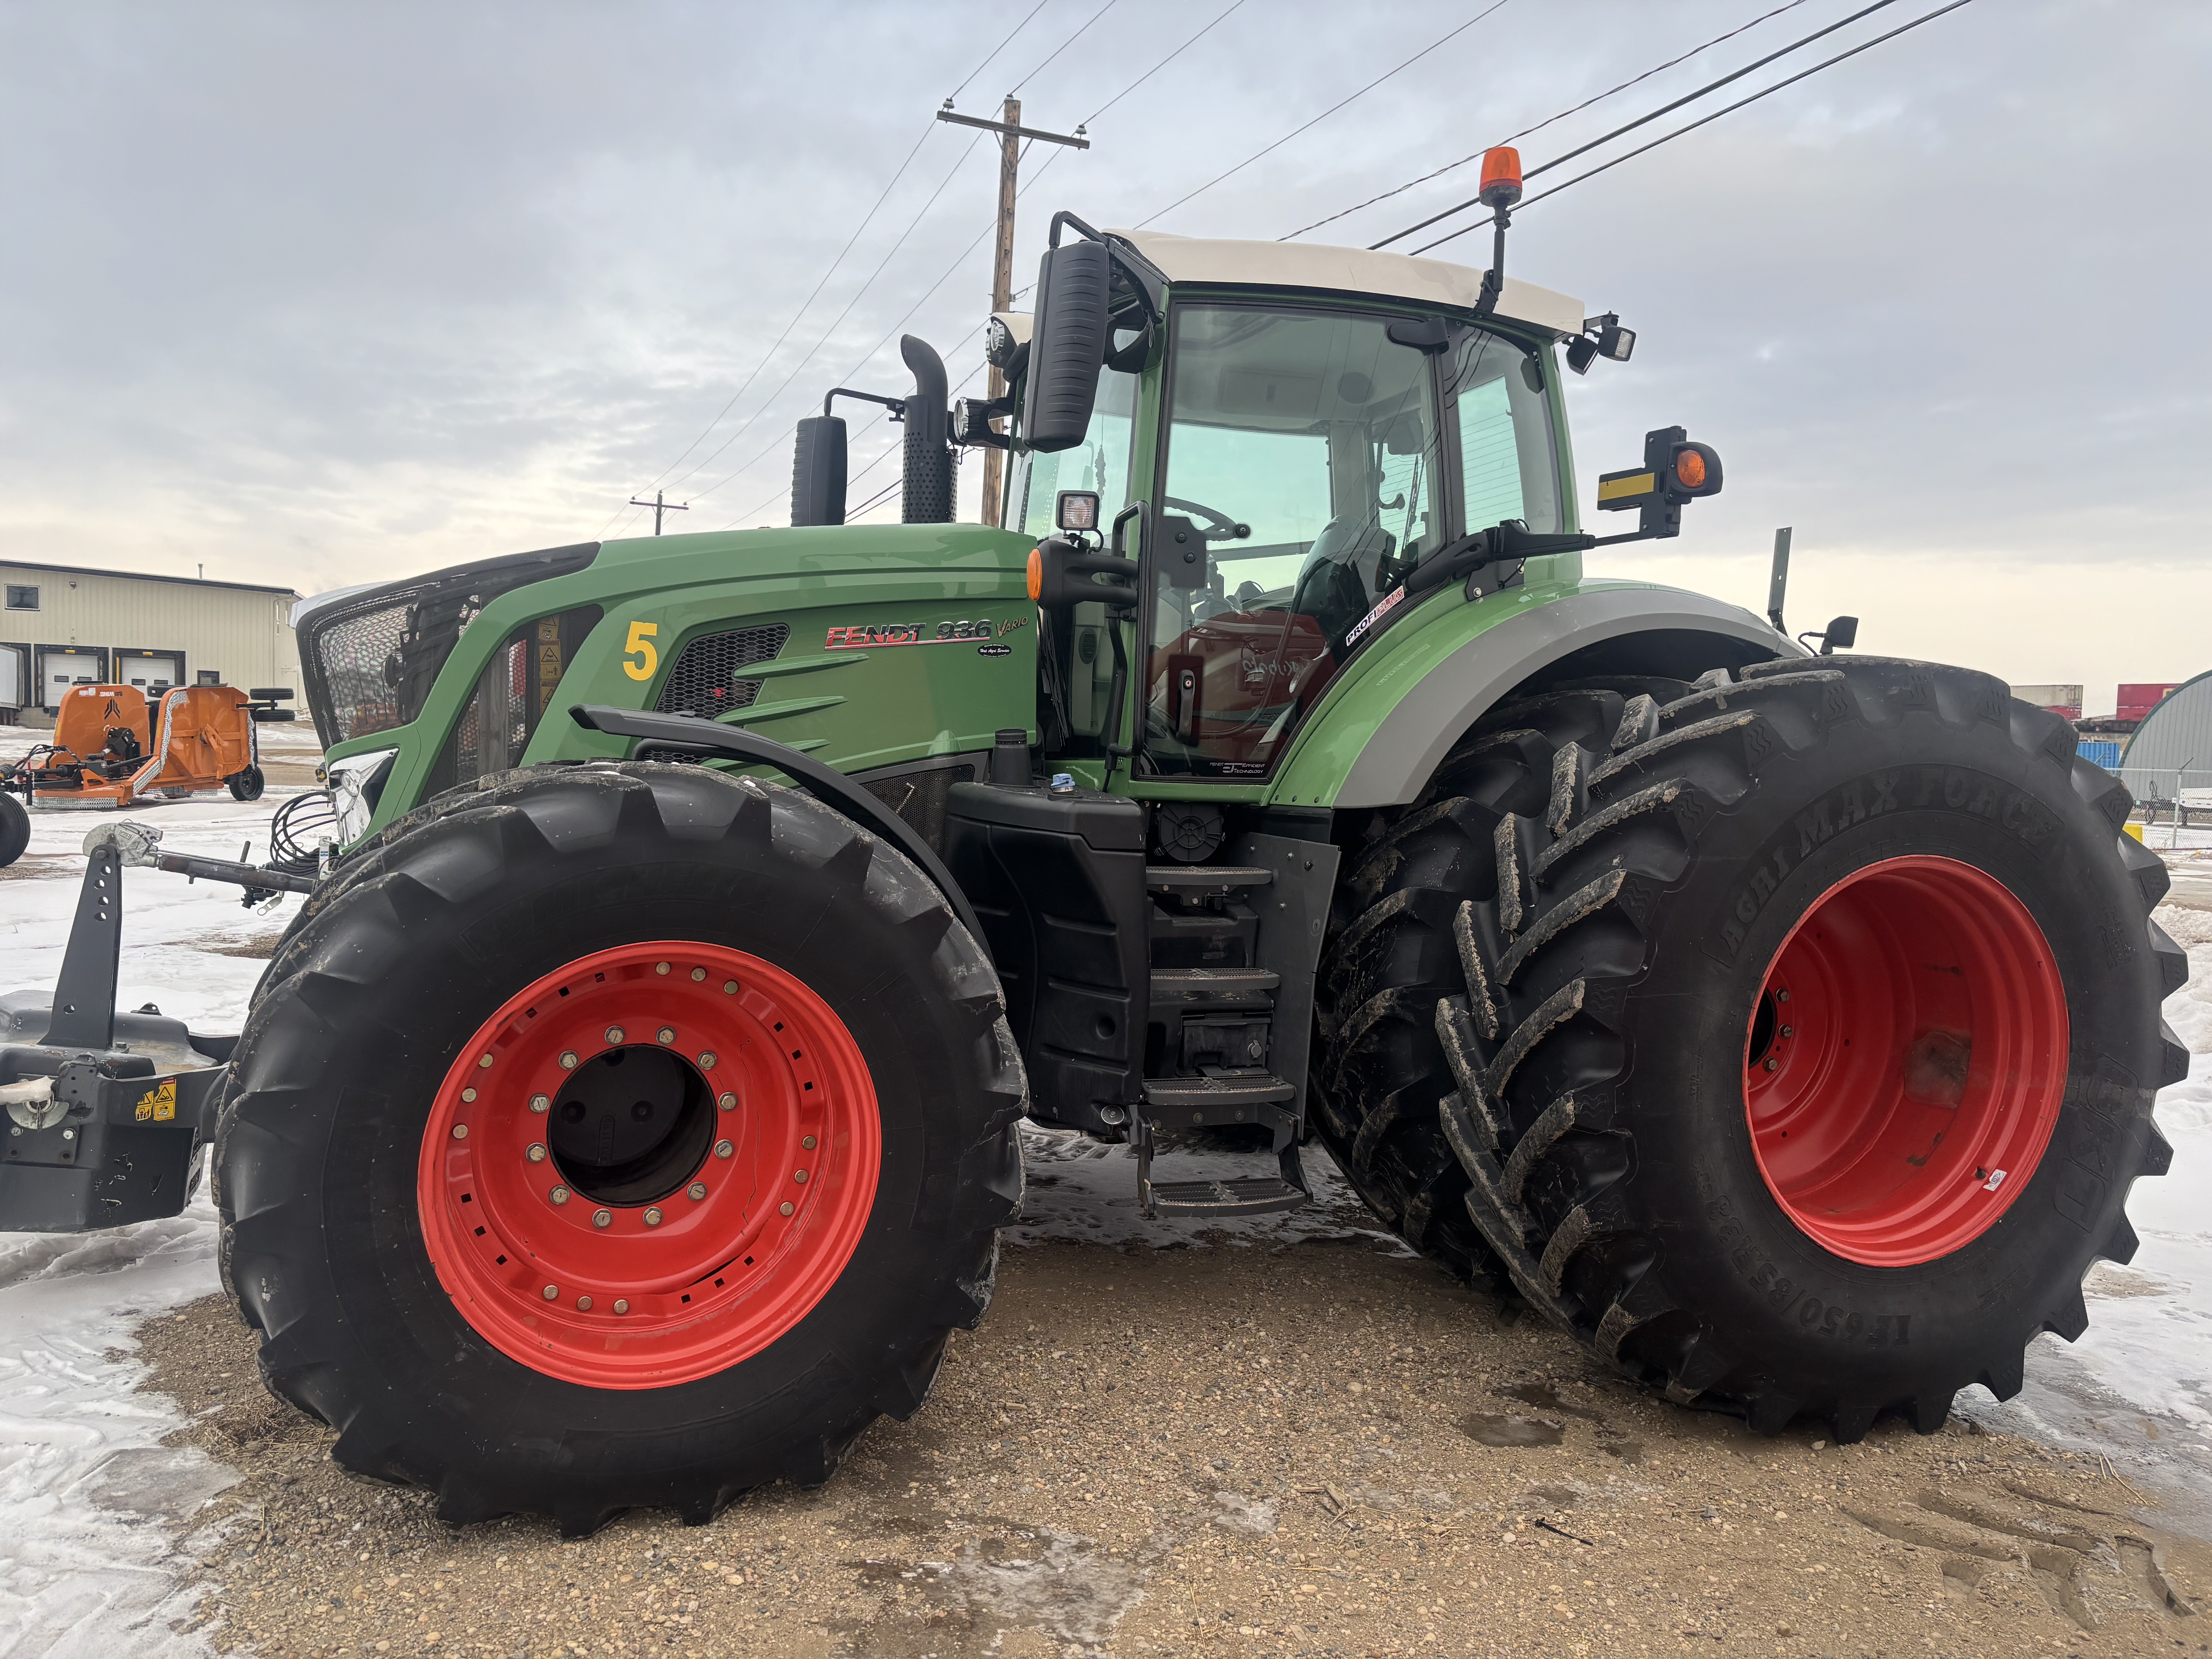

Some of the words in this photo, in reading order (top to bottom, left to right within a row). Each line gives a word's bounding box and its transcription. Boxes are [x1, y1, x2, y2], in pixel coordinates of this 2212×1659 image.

[826, 623, 926, 646] FENDT
[936, 619, 992, 640] 936
[1348, 587, 1403, 643] PROFIPLUS
[623, 621, 657, 681] 5
[1718, 848, 1794, 957] AGRI
[1792, 771, 1899, 858] MAX
